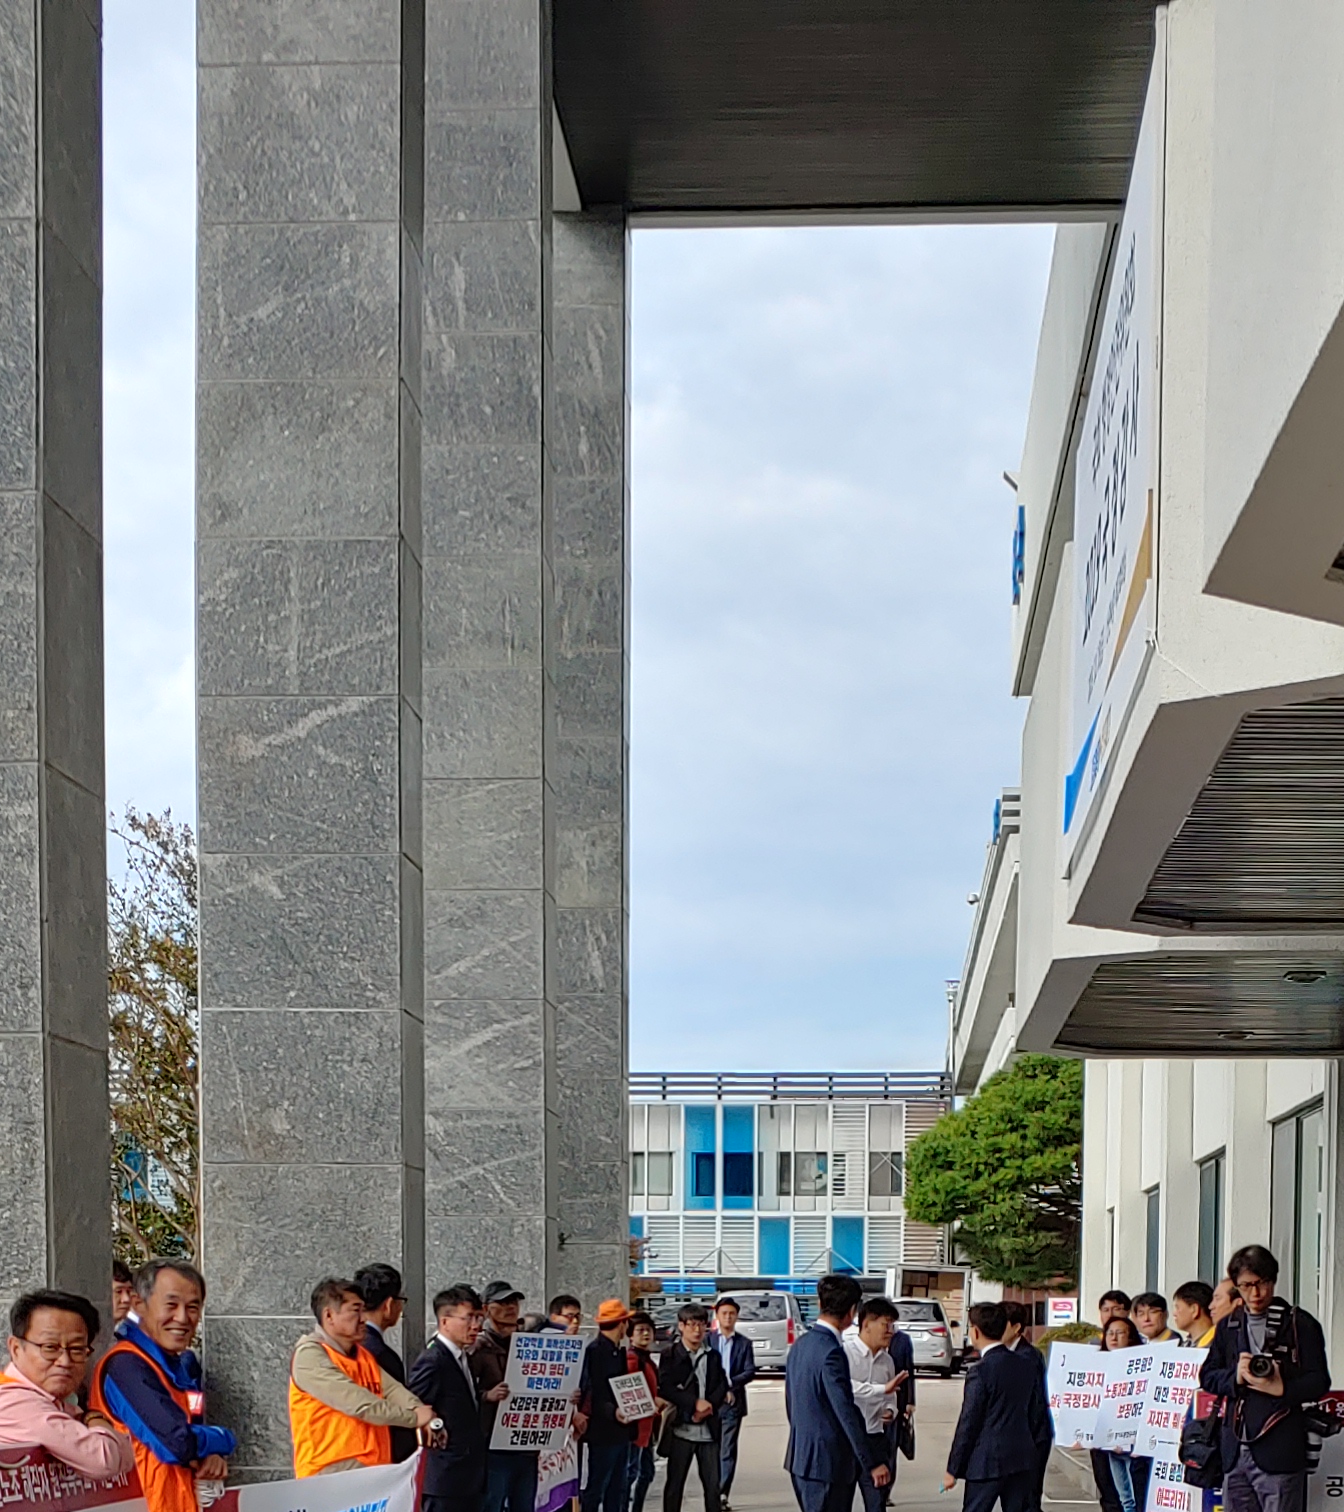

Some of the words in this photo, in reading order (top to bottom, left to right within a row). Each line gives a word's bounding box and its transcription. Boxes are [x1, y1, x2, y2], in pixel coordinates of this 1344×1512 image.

[1063, 1393, 1101, 1409] 국정감사
[1154, 1386, 1170, 1403] 대한
[501, 1412, 520, 1428] 어린
[510, 1430, 553, 1446] 건립하라!
[20, 1461, 52, 1503] 해직자
